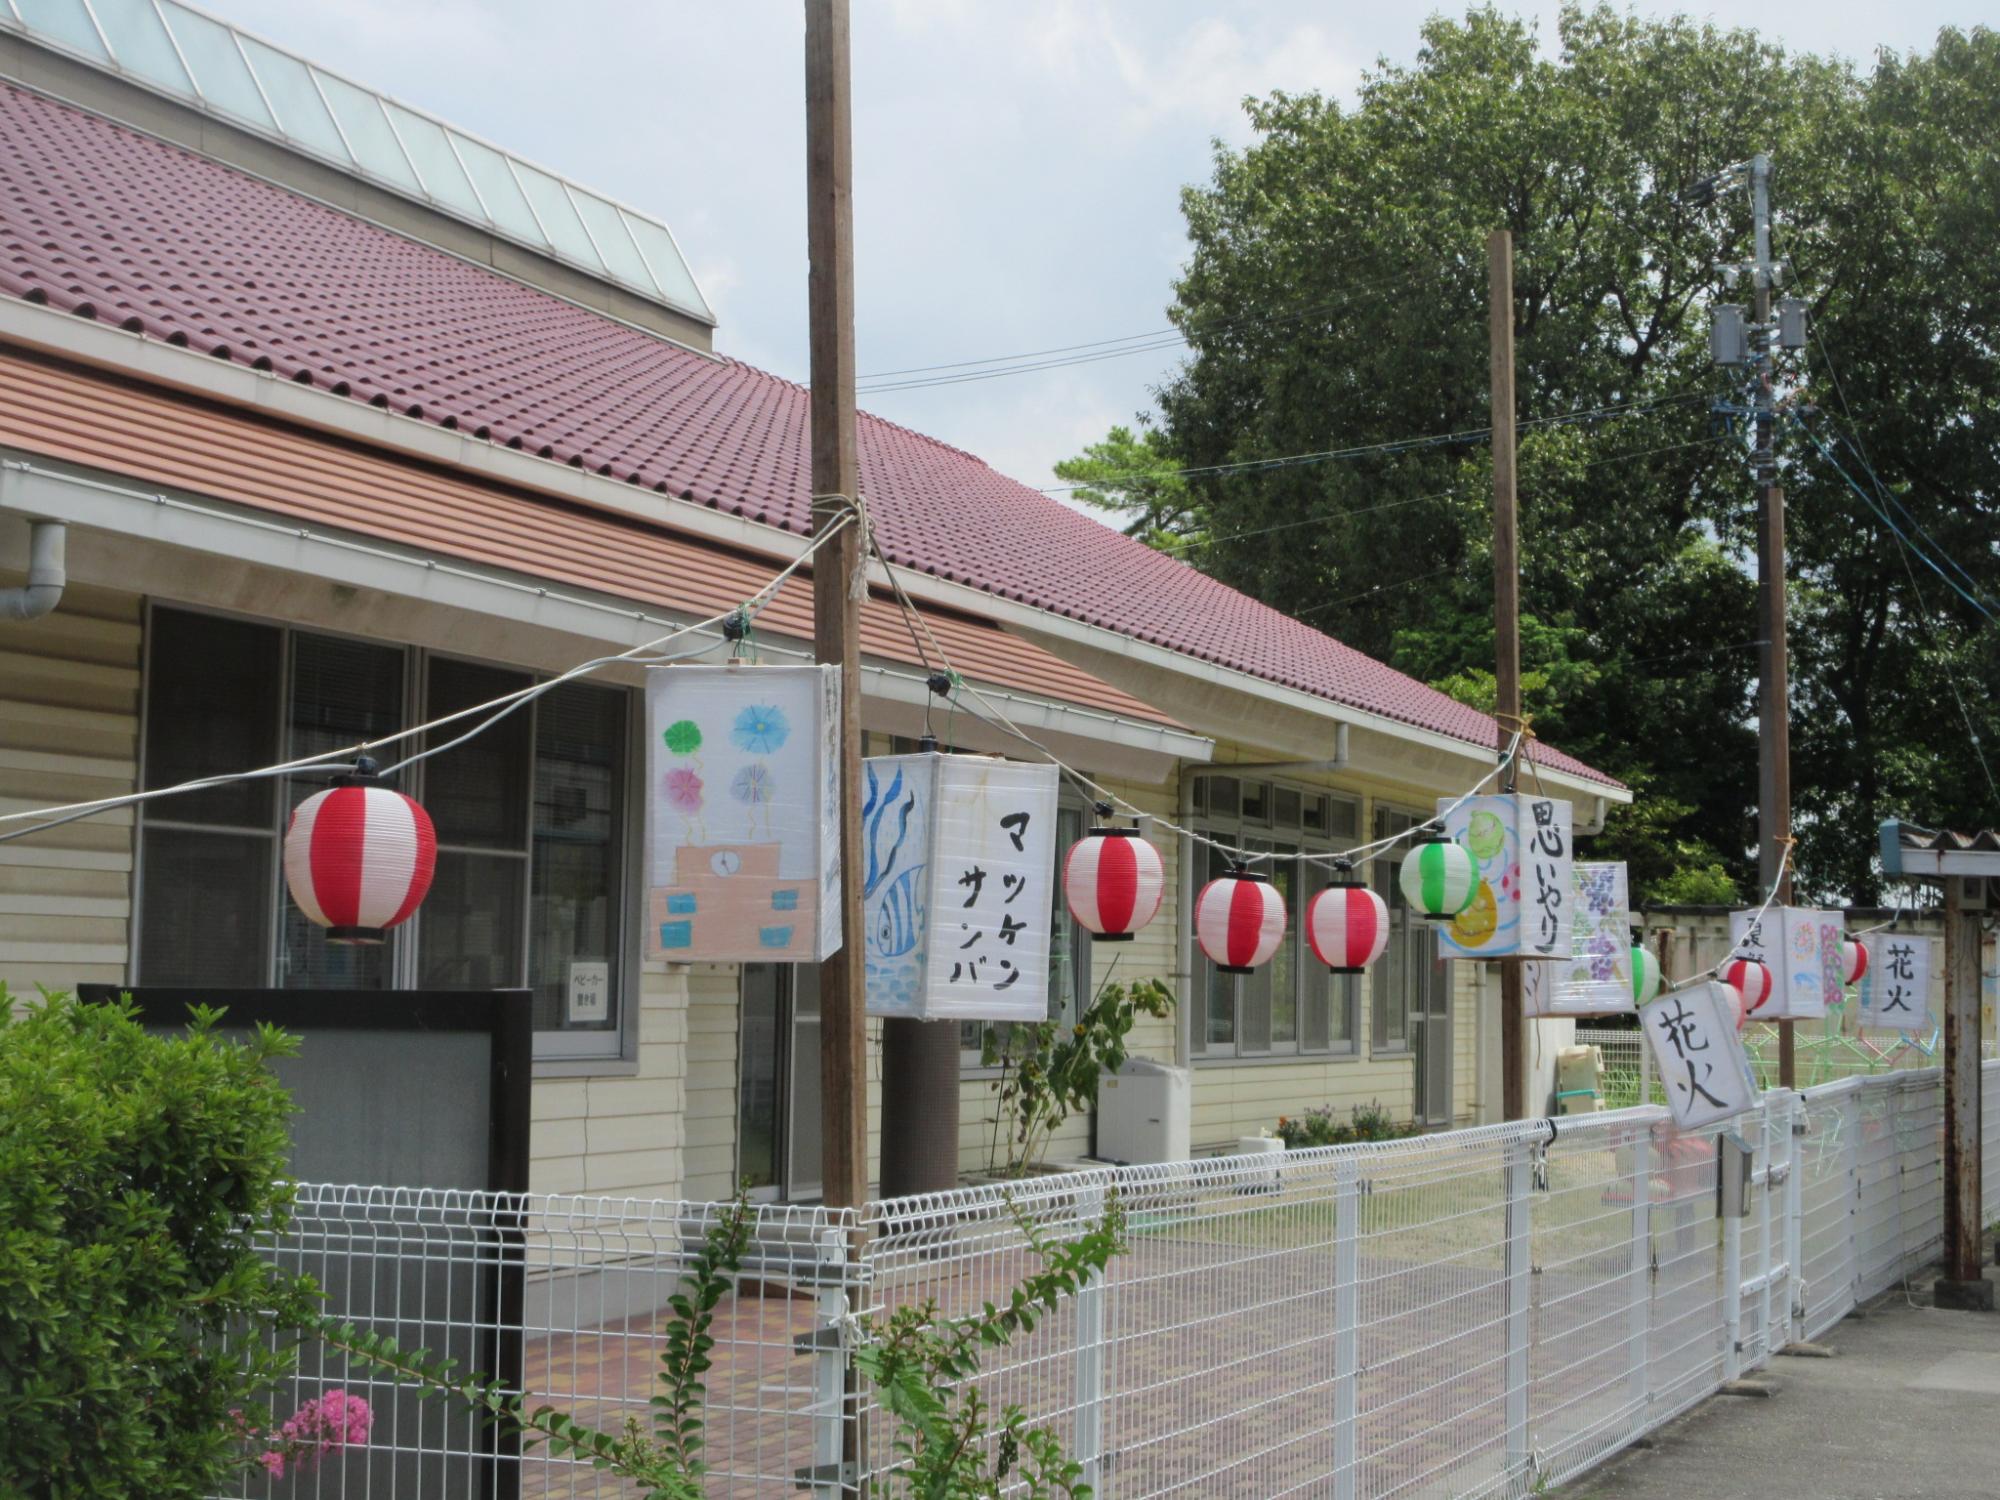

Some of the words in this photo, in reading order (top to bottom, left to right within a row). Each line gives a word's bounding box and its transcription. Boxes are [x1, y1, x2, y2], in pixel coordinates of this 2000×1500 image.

[950, 865, 987, 984] サンバ
[993, 812, 1030, 990] マツケン
[1530, 801, 1564, 954] 思いやり
[1883, 943, 1916, 1012] 花火
[1658, 999, 1729, 1118] 花火
